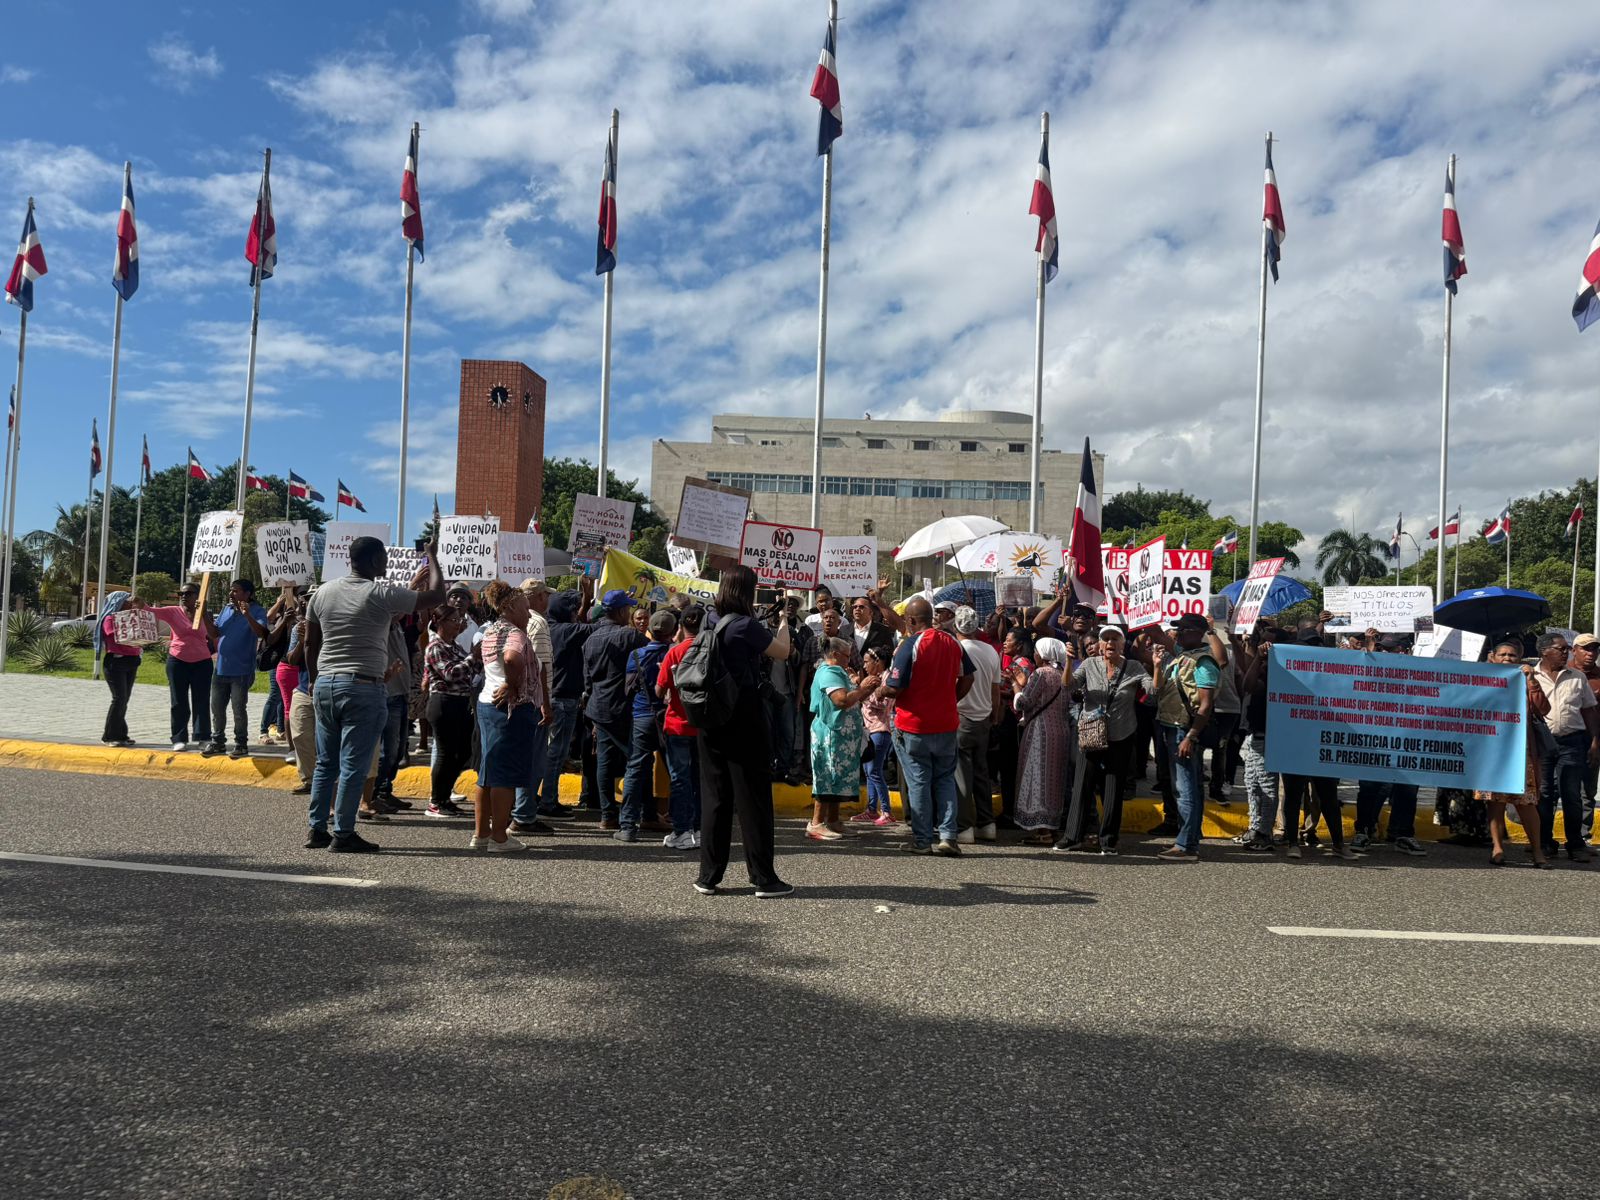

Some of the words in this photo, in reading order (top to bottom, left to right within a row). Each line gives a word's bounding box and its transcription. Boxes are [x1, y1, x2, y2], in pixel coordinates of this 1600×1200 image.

[212, 525, 221, 536] AL
[774, 530, 794, 548] NO
[468, 535, 480, 544] UN
[276, 551, 289, 564] SIN
[744, 547, 766, 557] MAS
[770, 550, 816, 563] DESALOJO
[1178, 552, 1207, 569] YA!
[774, 560, 781, 569] A
[786, 561, 799, 571] LA
[753, 567, 813, 582] TULACION
[823, 572, 872, 580] MERCANCÍA
[1138, 574, 1161, 591] DESALOJO
[1146, 589, 1153, 601] LA
[1353, 591, 1374, 600] NOS
[1129, 599, 1161, 621] TITULACION
[1286, 659, 1293, 670] EL
[1315, 661, 1322, 673] DE
[1366, 665, 1372, 677] DE
[1374, 666, 1383, 678] LOS
[1385, 667, 1408, 679] SOLARES
[1409, 669, 1434, 682] PAGADOS
[1435, 672, 1442, 683] AL
[1443, 672, 1449, 684] EL
[1449, 673, 1471, 685] ESTADO
[1353, 680, 1377, 692] ATRAVEZ
[1378, 682, 1385, 693] DE
[1386, 682, 1405, 695] BIENES
[1406, 685, 1440, 698] NACIONALES
[1318, 696, 1328, 707] LAS
[1330, 697, 1356, 709] FAMILIAS
[1357, 699, 1369, 711] QUE
[1371, 700, 1399, 714] PAGAMOS
[1399, 703, 1404, 714] A
[1405, 703, 1425, 715] BIENES
[1426, 705, 1461, 718] NACIONALES
[1462, 708, 1475, 720] MAS
[1476, 709, 1483, 720] DE
[1493, 711, 1520, 724] MILLONES
[1290, 708, 1298, 718] DE
[1299, 709, 1318, 720] PESOS
[1320, 711, 1335, 722] PARA
[1336, 712, 1363, 724] ADQUIRIR
[1365, 714, 1373, 725] UN
[1395, 717, 1422, 729] PEDIMOS
[1423, 720, 1434, 731] UNA
[1321, 730, 1333, 743] ES
[1334, 731, 1345, 745] DE
[1347, 732, 1388, 748] JUSTICIA
[1390, 735, 1400, 750] LO
[1403, 737, 1421, 752] QUE
[1320, 748, 1333, 762] SR.
[1336, 750, 1391, 767] PRESIDENTE
[1397, 754, 1417, 769] LUIS
[1420, 757, 1464, 773] ABINADER
